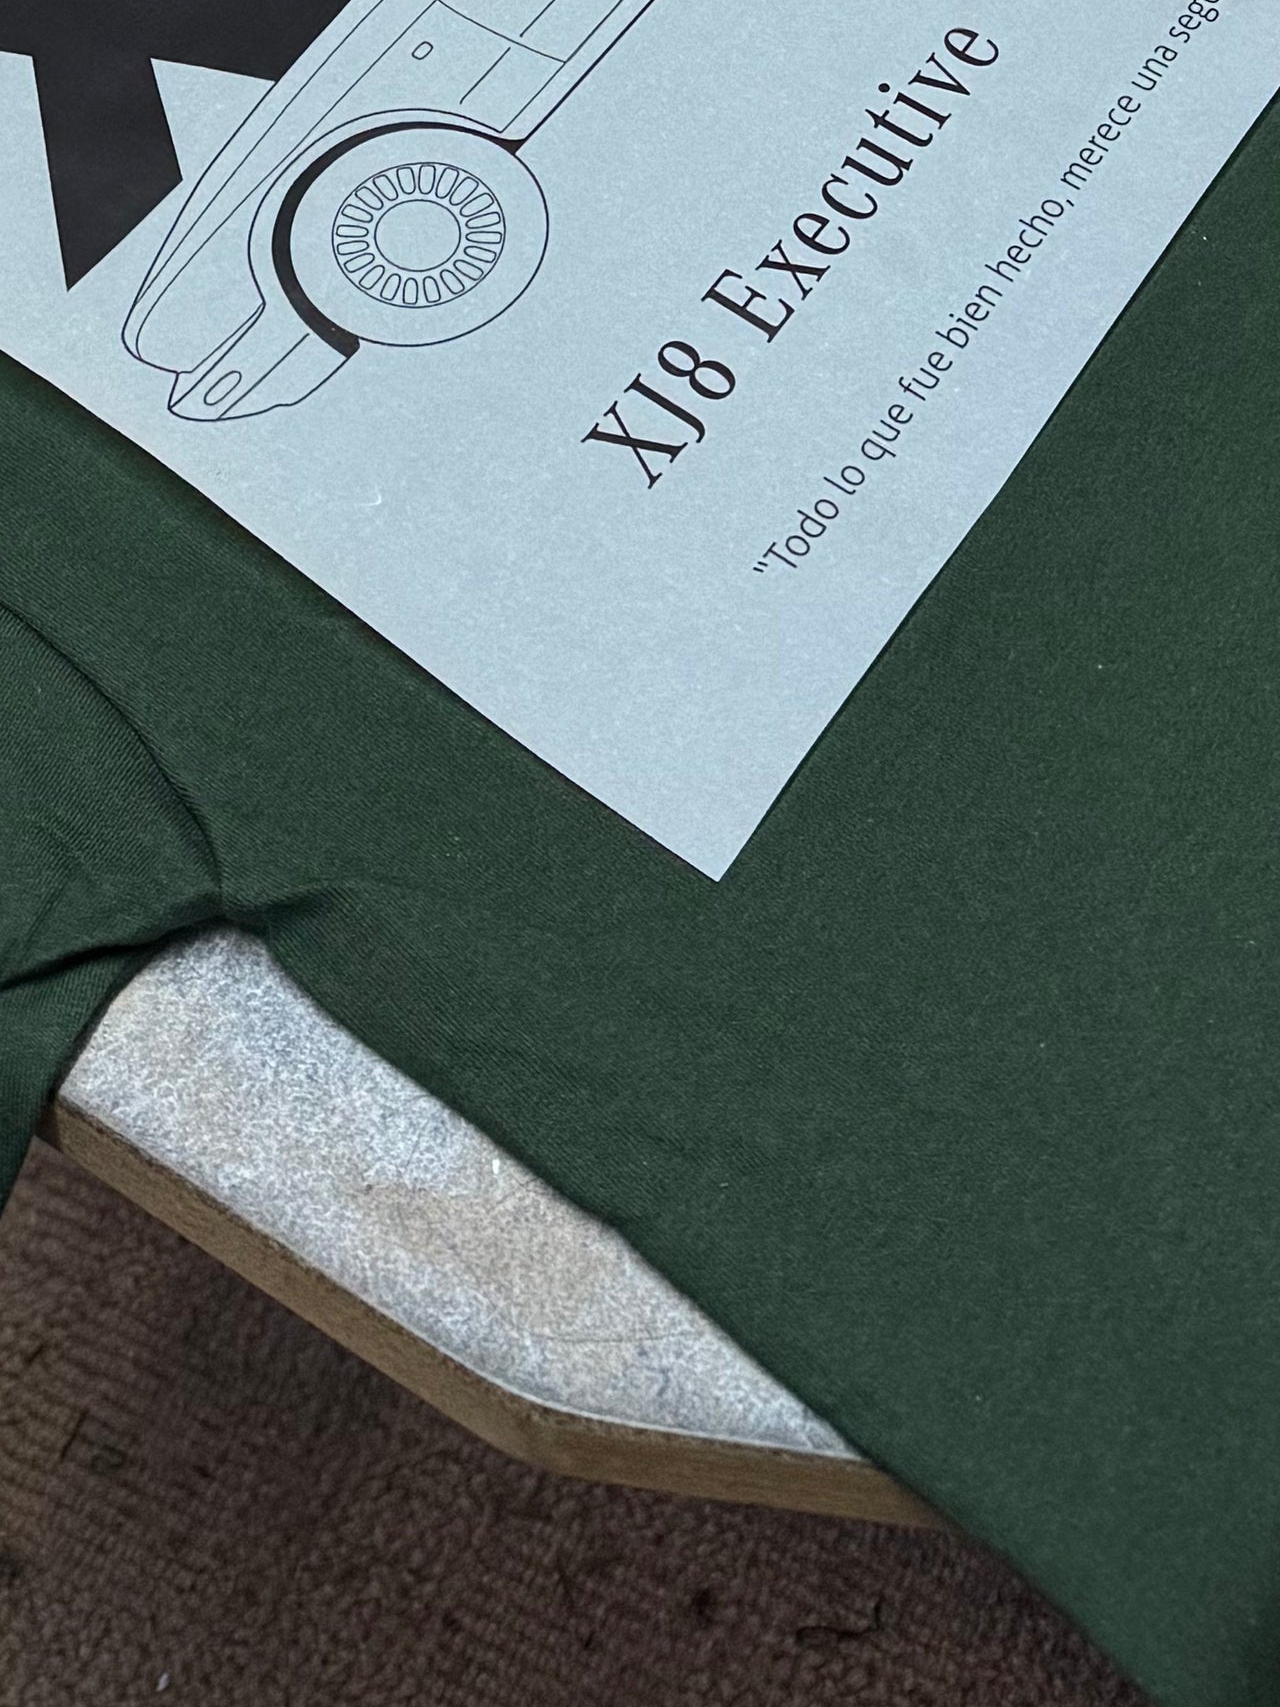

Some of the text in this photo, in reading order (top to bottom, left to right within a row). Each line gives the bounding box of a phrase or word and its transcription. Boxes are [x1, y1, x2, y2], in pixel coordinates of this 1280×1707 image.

[581, 340, 737, 490] XJ8
[700, 26, 1000, 344] Executive
[752, 498, 840, 573] "Todo
[823, 465, 866, 496] lo
[860, 403, 914, 461] que
[898, 351, 954, 402] fue
[935, 284, 1003, 349] bien
[984, 198, 1075, 283] hecho,
[1060, 93, 1141, 191] merece
[1131, 43, 1178, 92] una
